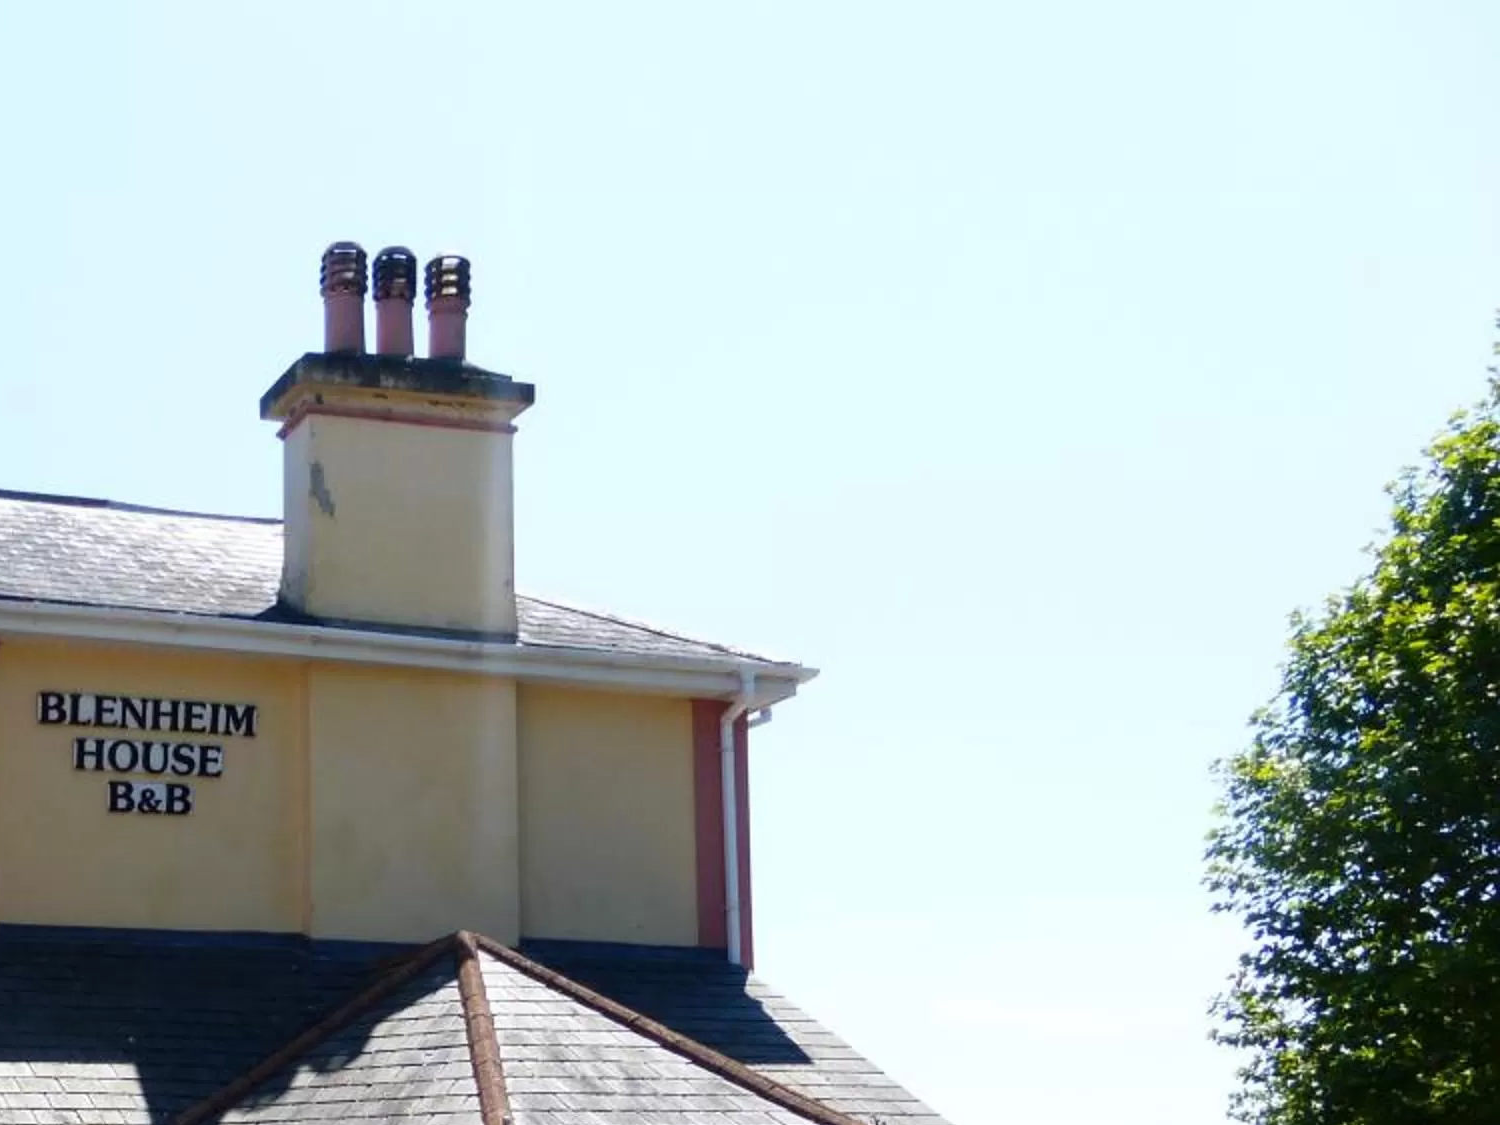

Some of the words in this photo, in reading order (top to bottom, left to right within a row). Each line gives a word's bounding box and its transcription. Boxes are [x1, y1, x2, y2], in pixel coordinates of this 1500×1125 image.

[38, 691, 256, 737] BLENHEIM
[73, 737, 223, 777] HOUSE
[107, 780, 193, 815] B&B
